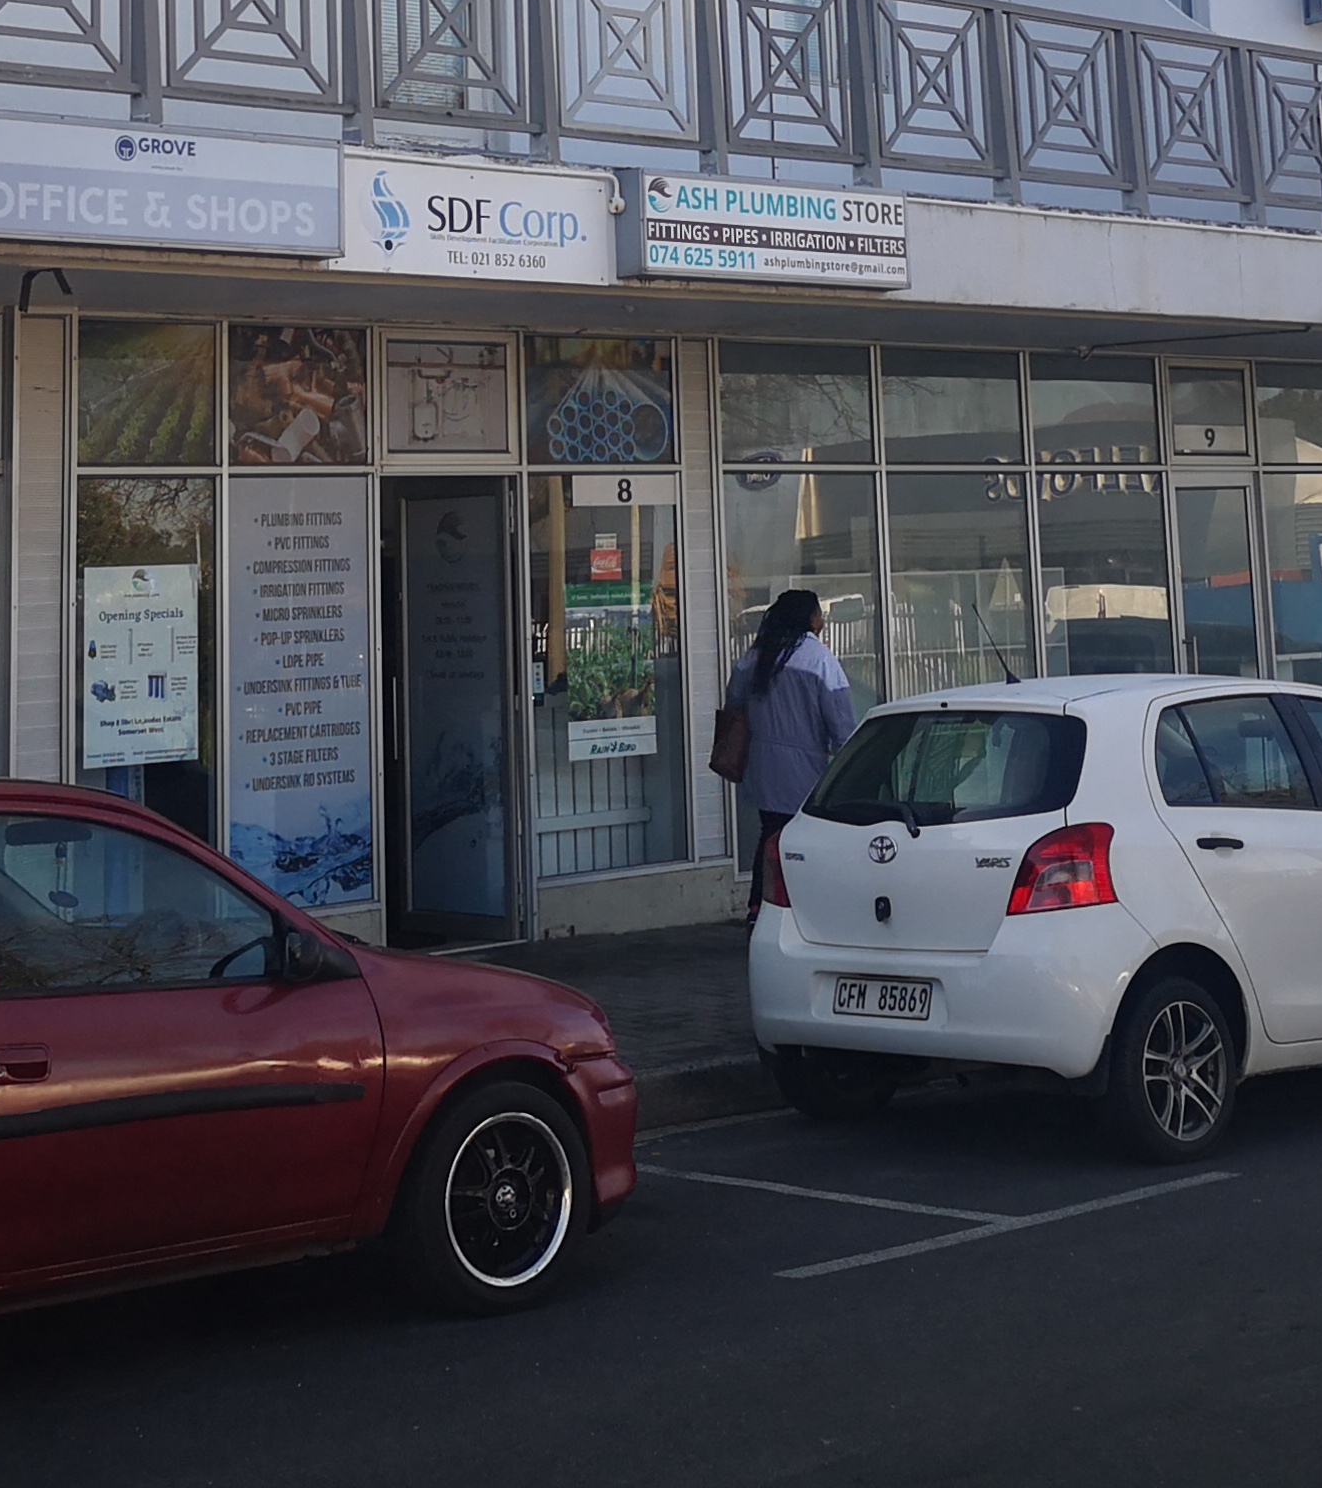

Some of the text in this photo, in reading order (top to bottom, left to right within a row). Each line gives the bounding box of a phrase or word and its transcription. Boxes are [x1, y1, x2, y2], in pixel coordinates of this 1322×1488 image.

[138, 137, 196, 157] GROVE
[143, 191, 172, 228] &
[187, 194, 315, 237] SHOPS
[676, 185, 903, 226] ASH PLUMBING STORE
[427, 195, 587, 247] SDF Corp.
[430, 233, 558, 247] Skills Development Facilitation Corporation
[648, 221, 905, 255] FITTINGS PIPES IRRIGATION FILTERS
[447, 250, 546, 268] TEL: 021 852 6360
[649, 244, 756, 269] 074 625 5911
[764, 256, 905, 276] ashplumbingstore@gmail.com
[1204, 428, 1215, 448] 9
[617, 478, 632, 503] 8
[261, 512, 342, 527] PLUMBING FITTINGS
[274, 536, 329, 550] PVC FITTINGS
[253, 558, 351, 575] COMPRESSION FITTINGS
[260, 582, 344, 598] IRRIGATION FITTINGS
[99, 607, 184, 624] Opening Specials
[262, 605, 342, 622] MICRO SPRINKLERS
[261, 628, 345, 646] POP-UP SPRINKLERS
[282, 653, 325, 669] LDPE PIPE
[244, 678, 293, 695] UNDERSINK
[294, 676, 331, 693] FITTINGS
[341, 674, 362, 688] TUBE
[285, 700, 322, 716] PVC PIPE
[246, 721, 360, 744] REPLACEMENT CARTRIDGES
[269, 747, 338, 766] 3 STAGE FILTERS
[252, 774, 300, 792] UNDERSINK
[317, 769, 355, 786] SYSTEMS
[838, 980, 928, 1013] CFM 85869
